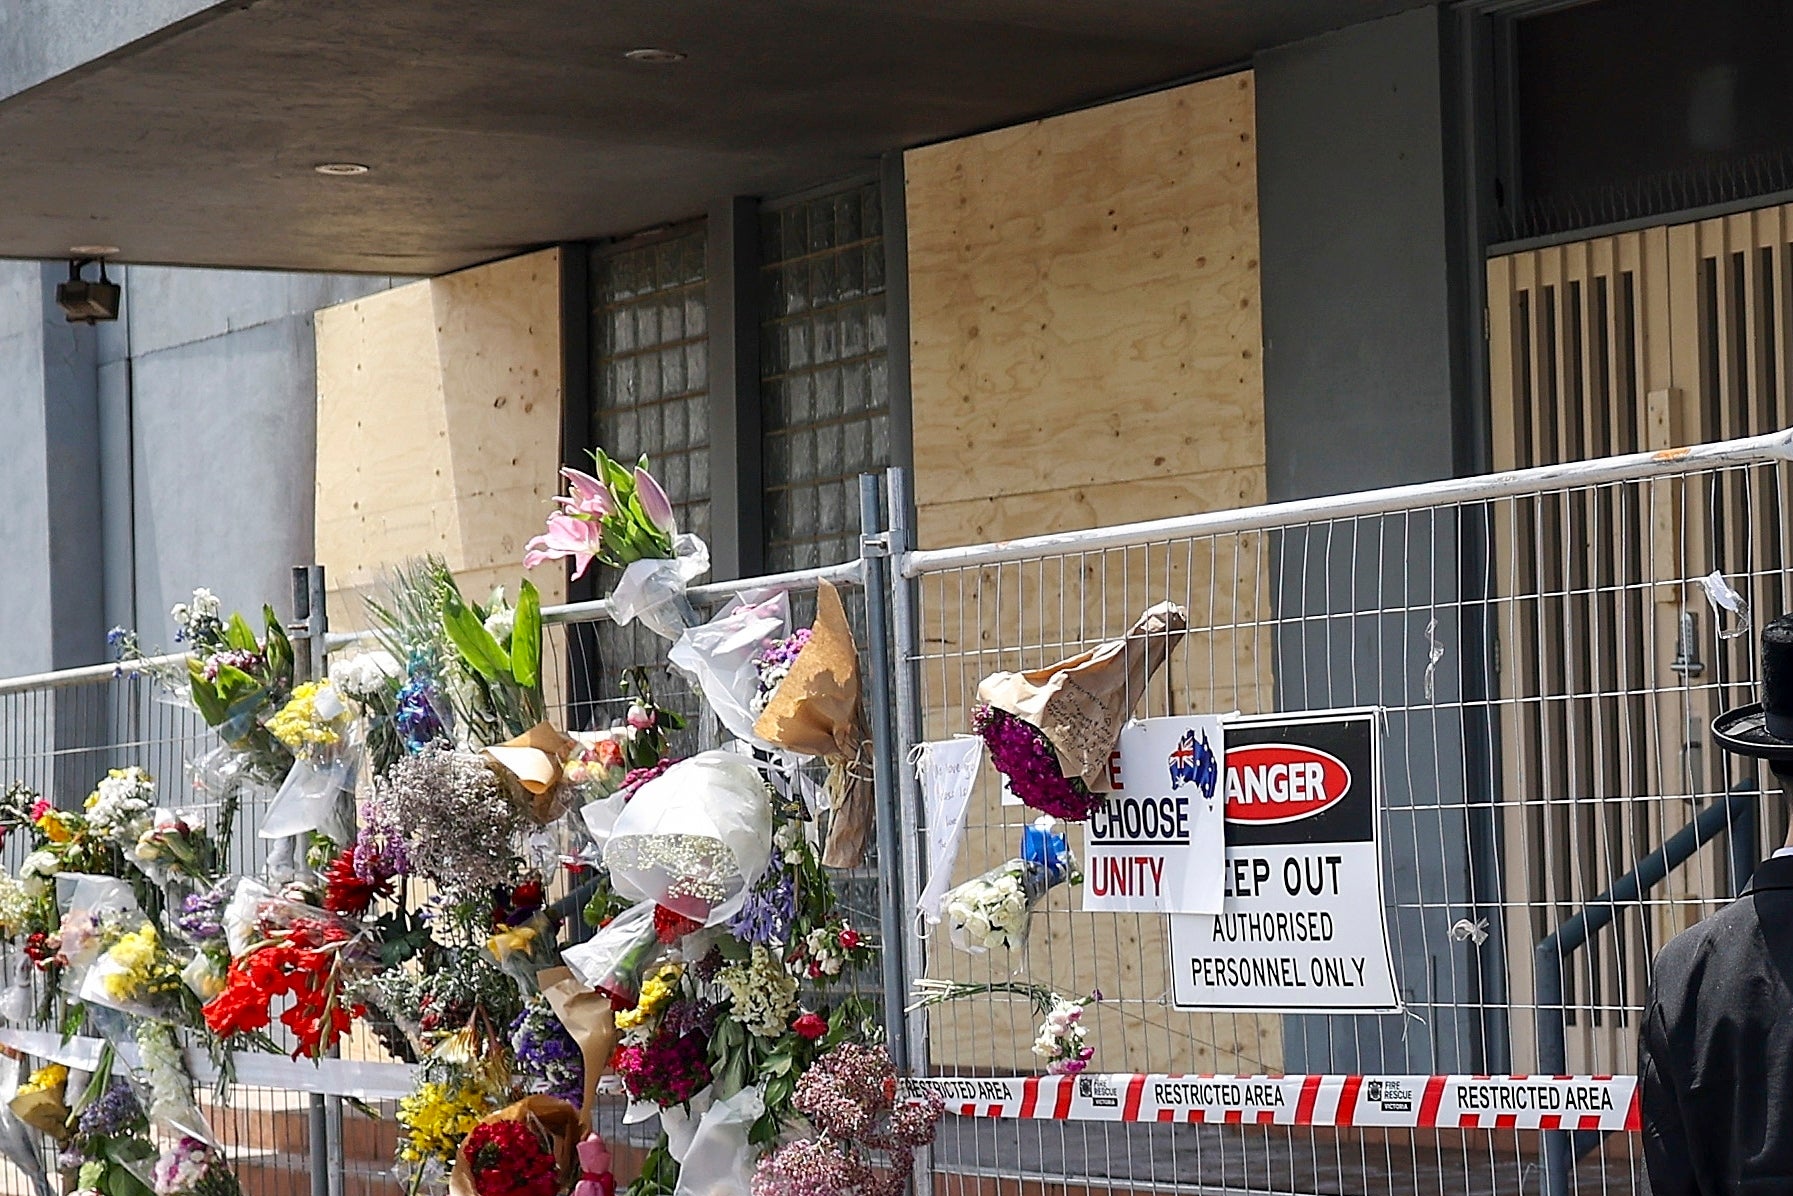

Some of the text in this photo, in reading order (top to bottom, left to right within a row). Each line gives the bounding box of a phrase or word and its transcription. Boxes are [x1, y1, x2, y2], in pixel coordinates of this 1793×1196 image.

[1102, 751, 1124, 791] E
[1225, 762, 1327, 805] ANGER
[1091, 797, 1190, 839] CHOOSE
[1092, 856, 1164, 897] UNITY
[1284, 856, 1342, 897] OUT
[1213, 911, 1334, 942] AUTHORISED
[1191, 957, 1365, 988] PERSONNEL ONLY
[978, 1081, 1012, 1100] AREA
[1155, 1083, 1285, 1106] RESTRICTED AREA
[1384, 1090, 1412, 1099] RESCUE
[1385, 1081, 1400, 1090] FIRE
[1457, 1086, 1613, 1110] RESTRICTED AREA
